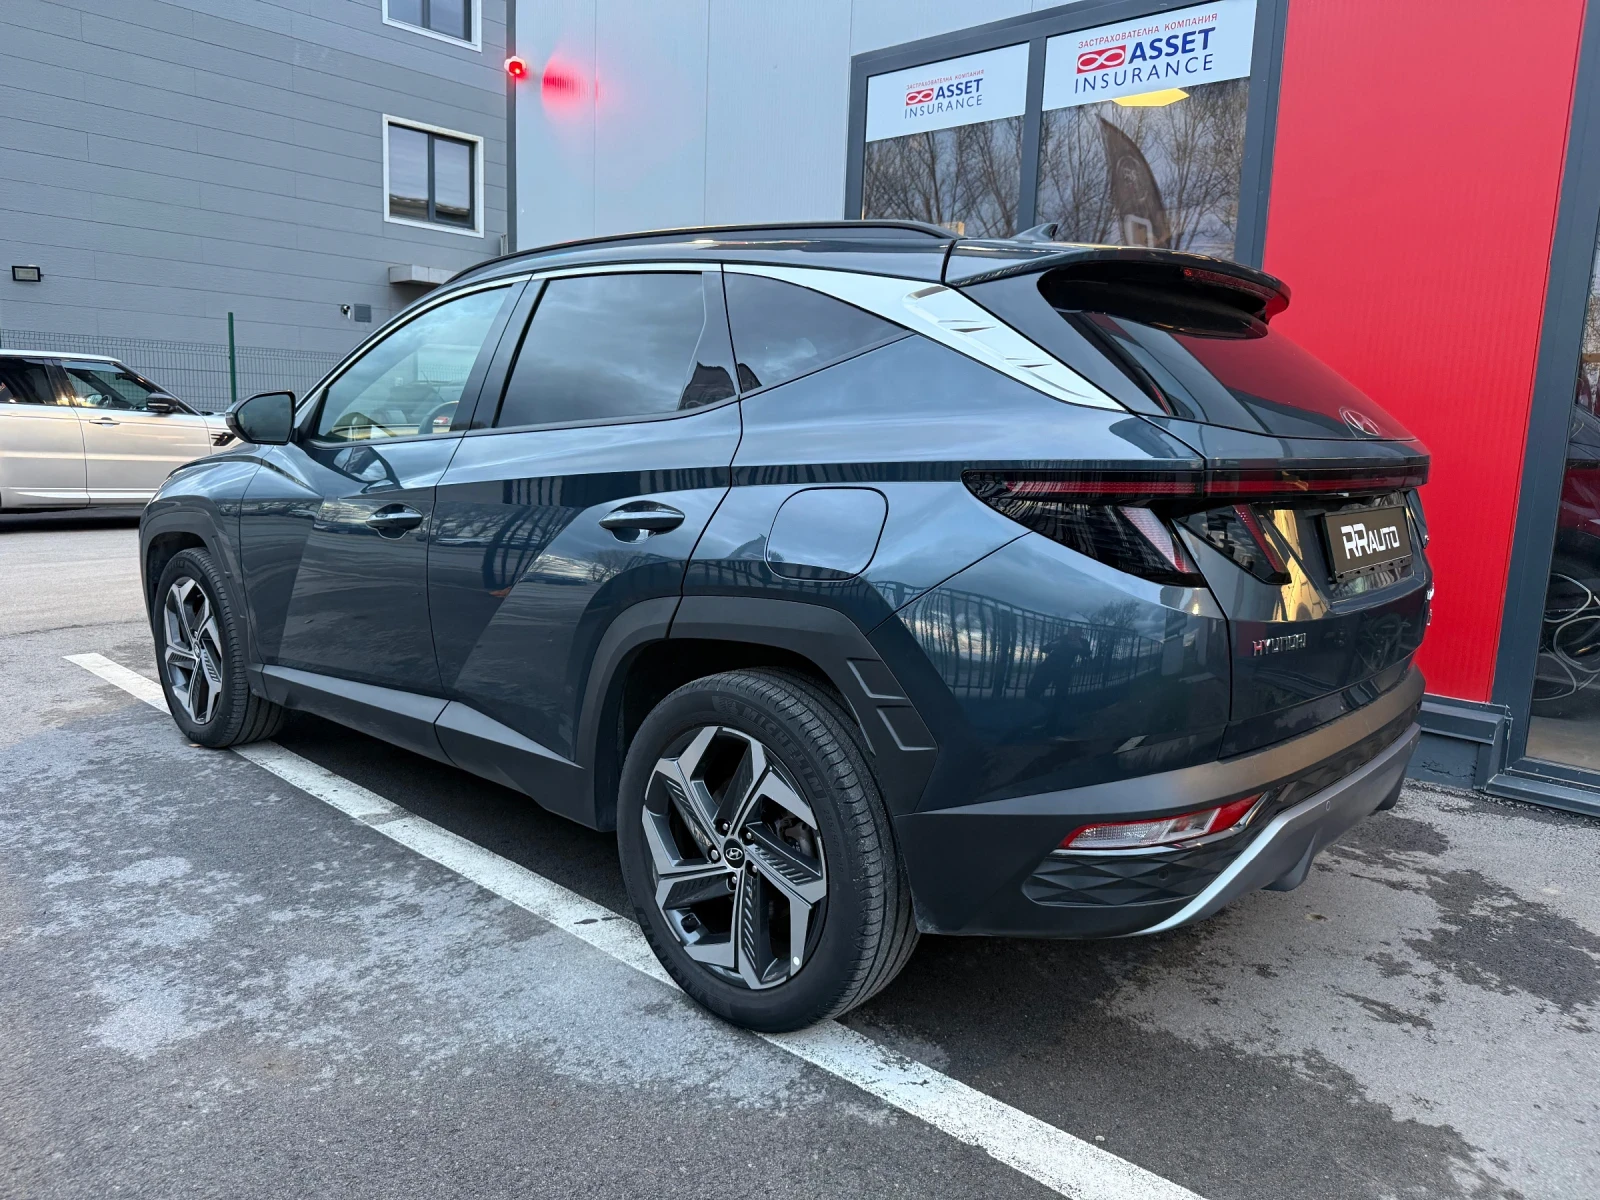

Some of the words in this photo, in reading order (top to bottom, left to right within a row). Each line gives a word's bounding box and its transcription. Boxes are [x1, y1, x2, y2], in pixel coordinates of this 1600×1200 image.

[1078, 25, 1159, 49] ЗАСТРАХОВАТЕЛНА
[1164, 13, 1218, 31] КОМПАНИЯ
[1127, 26, 1216, 65] ASSET
[906, 76, 953, 90] ЗАСТРАХОВАТЕЛНА
[955, 69, 985, 80] КОМПАНИЯ
[1075, 53, 1214, 94] INSURANCE
[935, 78, 984, 100] ASSET
[904, 94, 983, 119] INSURANCE
[1252, 632, 1307, 657] HYUNDAI
[742, 705, 824, 793] MICHELIN
